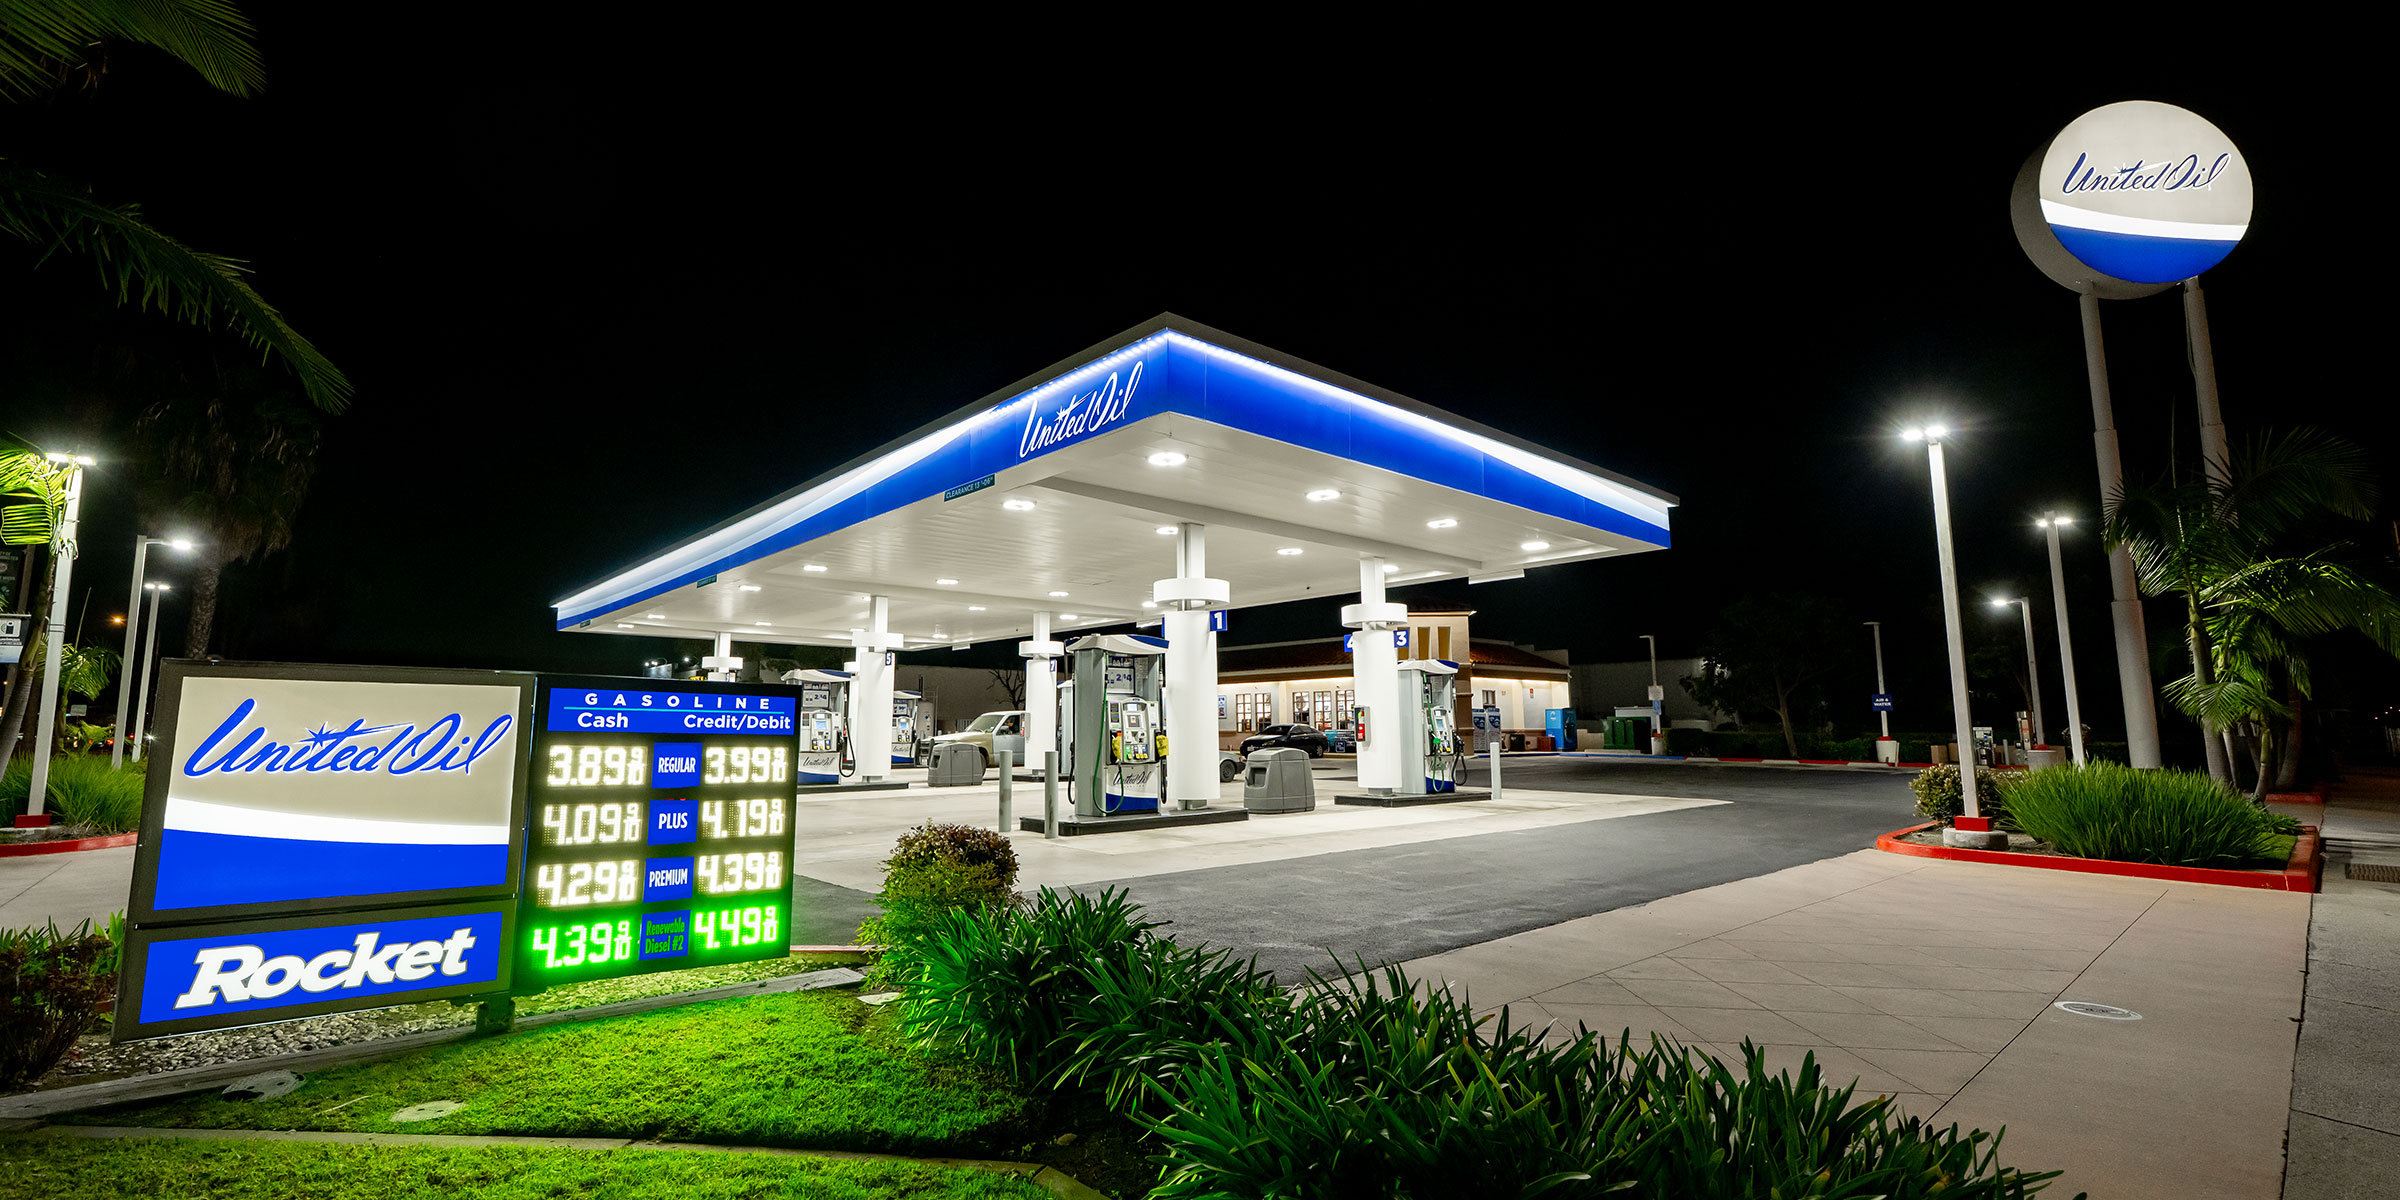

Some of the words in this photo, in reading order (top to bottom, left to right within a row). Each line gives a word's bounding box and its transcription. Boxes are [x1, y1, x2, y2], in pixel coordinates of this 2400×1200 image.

[2062, 151, 2171, 194] United
[2163, 151, 2232, 193] Oil
[1019, 390, 1097, 458] United
[1088, 360, 1144, 432] Oil
[945, 483, 974, 499] CLEARANCE
[1213, 611, 1223, 630] 1
[1396, 631, 1408, 646] 3
[886, 652, 892, 666] 5
[1050, 660, 1056, 672] 7
[584, 693, 770, 710] GASOLINE
[577, 712, 629, 729] Cash
[683, 714, 791, 731] Credit/Debit
[182, 697, 415, 778] United
[387, 712, 514, 777] Oil
[658, 756, 696, 774] REGULAR
[658, 812, 688, 830] PLUS
[649, 868, 688, 888] PREMIUM
[645, 916, 686, 936] Renewable
[644, 934, 671, 954] Diesel
[671, 934, 684, 952] #2
[173, 928, 477, 1010] Rocket
